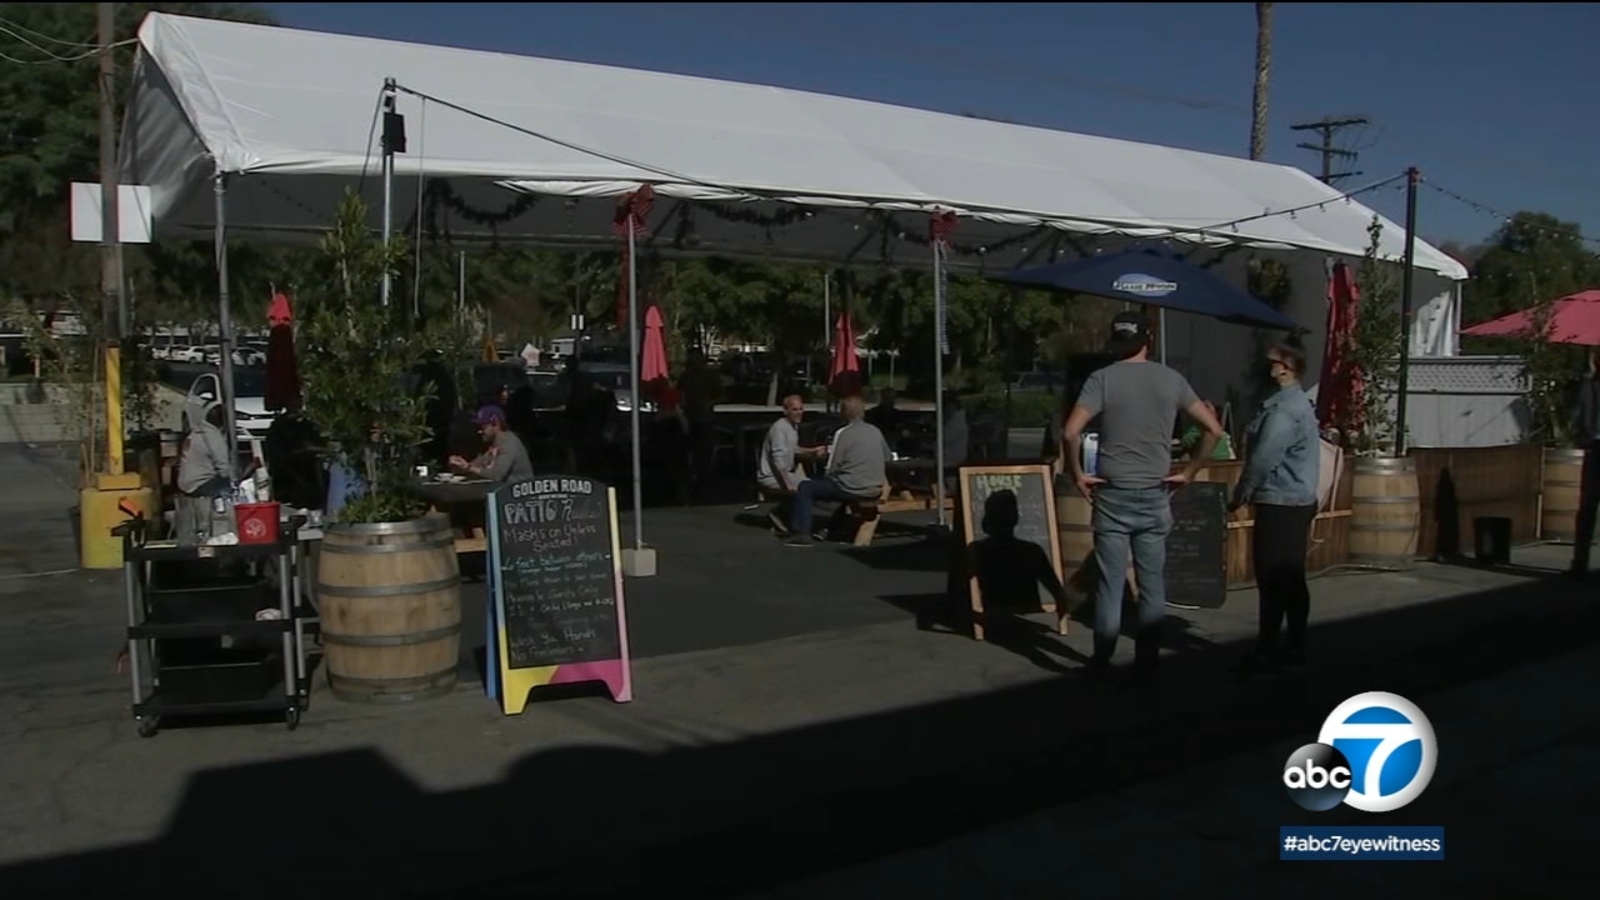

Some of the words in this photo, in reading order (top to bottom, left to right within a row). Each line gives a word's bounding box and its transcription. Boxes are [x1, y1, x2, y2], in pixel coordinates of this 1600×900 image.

[513, 479, 558, 498] GOLDEN
[560, 479, 592, 494] ROAD
[504, 500, 557, 524] PATIO
